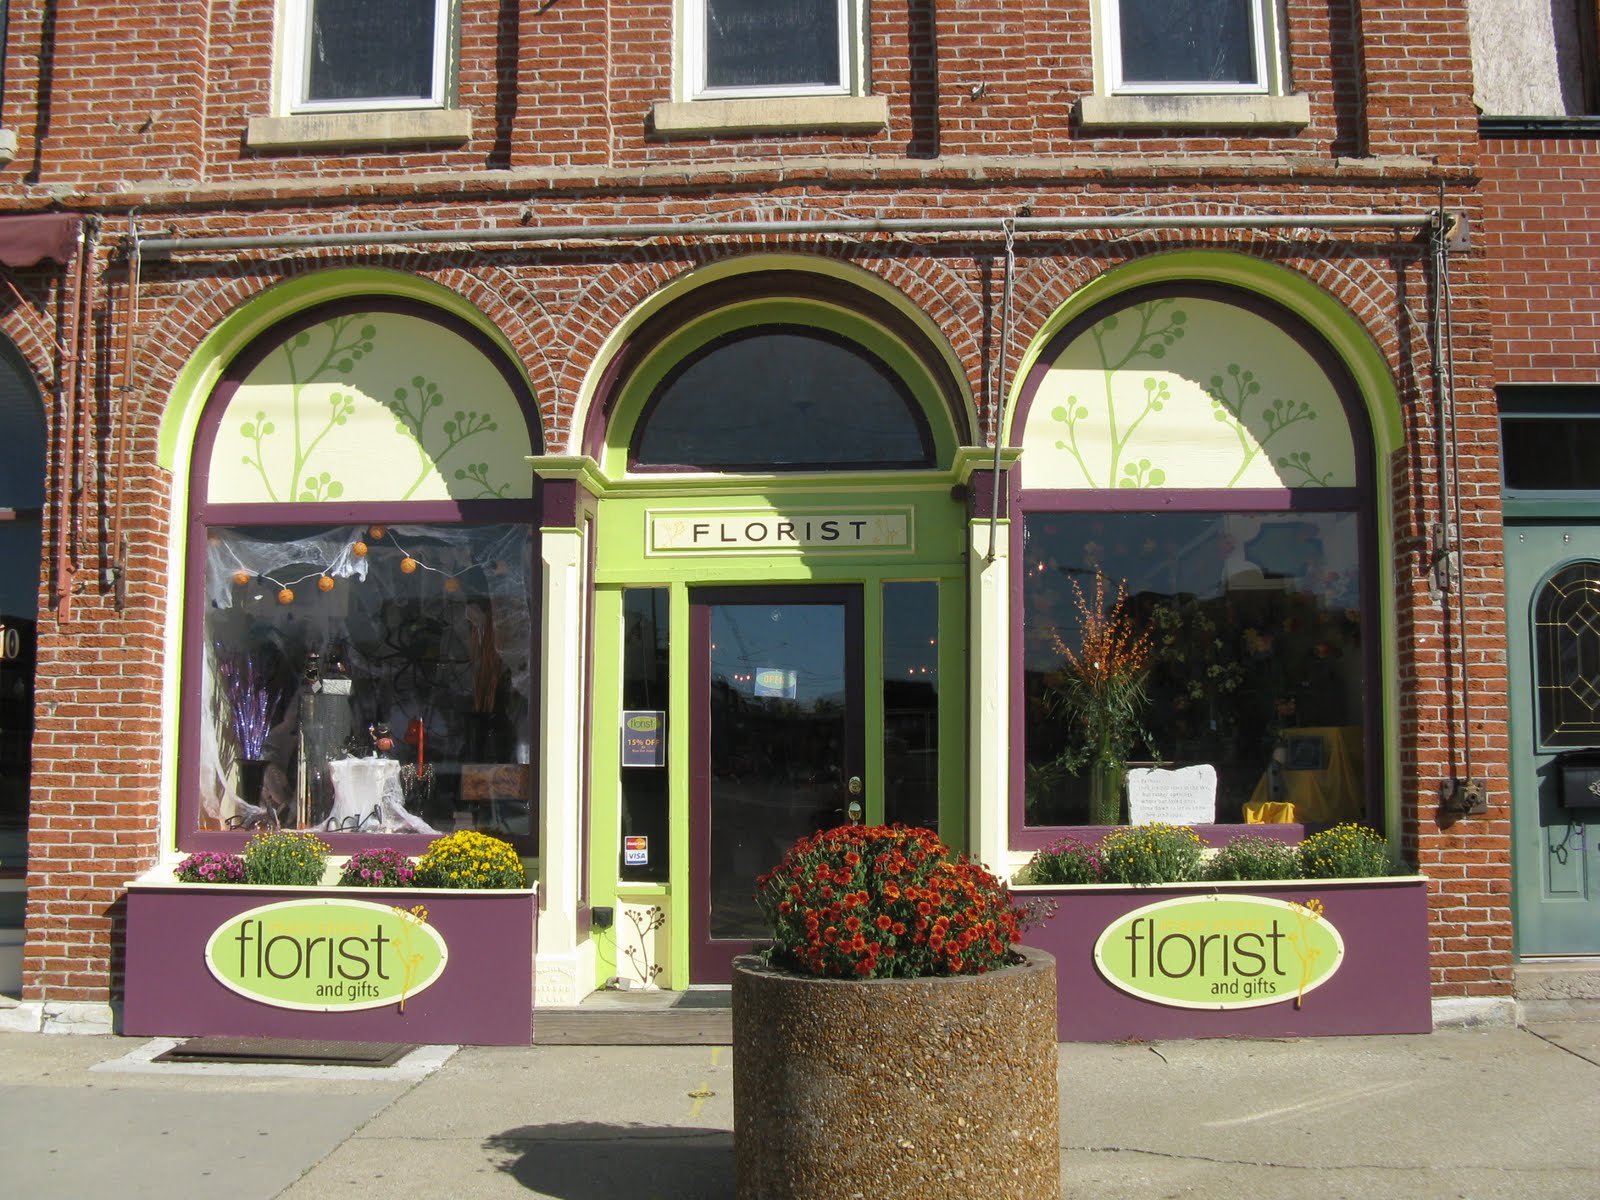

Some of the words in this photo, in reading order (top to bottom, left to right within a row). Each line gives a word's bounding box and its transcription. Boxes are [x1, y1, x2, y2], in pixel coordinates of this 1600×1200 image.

[693, 520, 867, 543] FLORIST
[627, 738, 644, 746] 15%
[629, 852, 646, 860] VISA
[234, 919, 390, 981] florist
[1124, 917, 1286, 979] florist
[316, 981, 343, 997] and
[347, 981, 380, 1001] gifts
[1210, 978, 1239, 995] and
[1243, 977, 1276, 999] gifts
